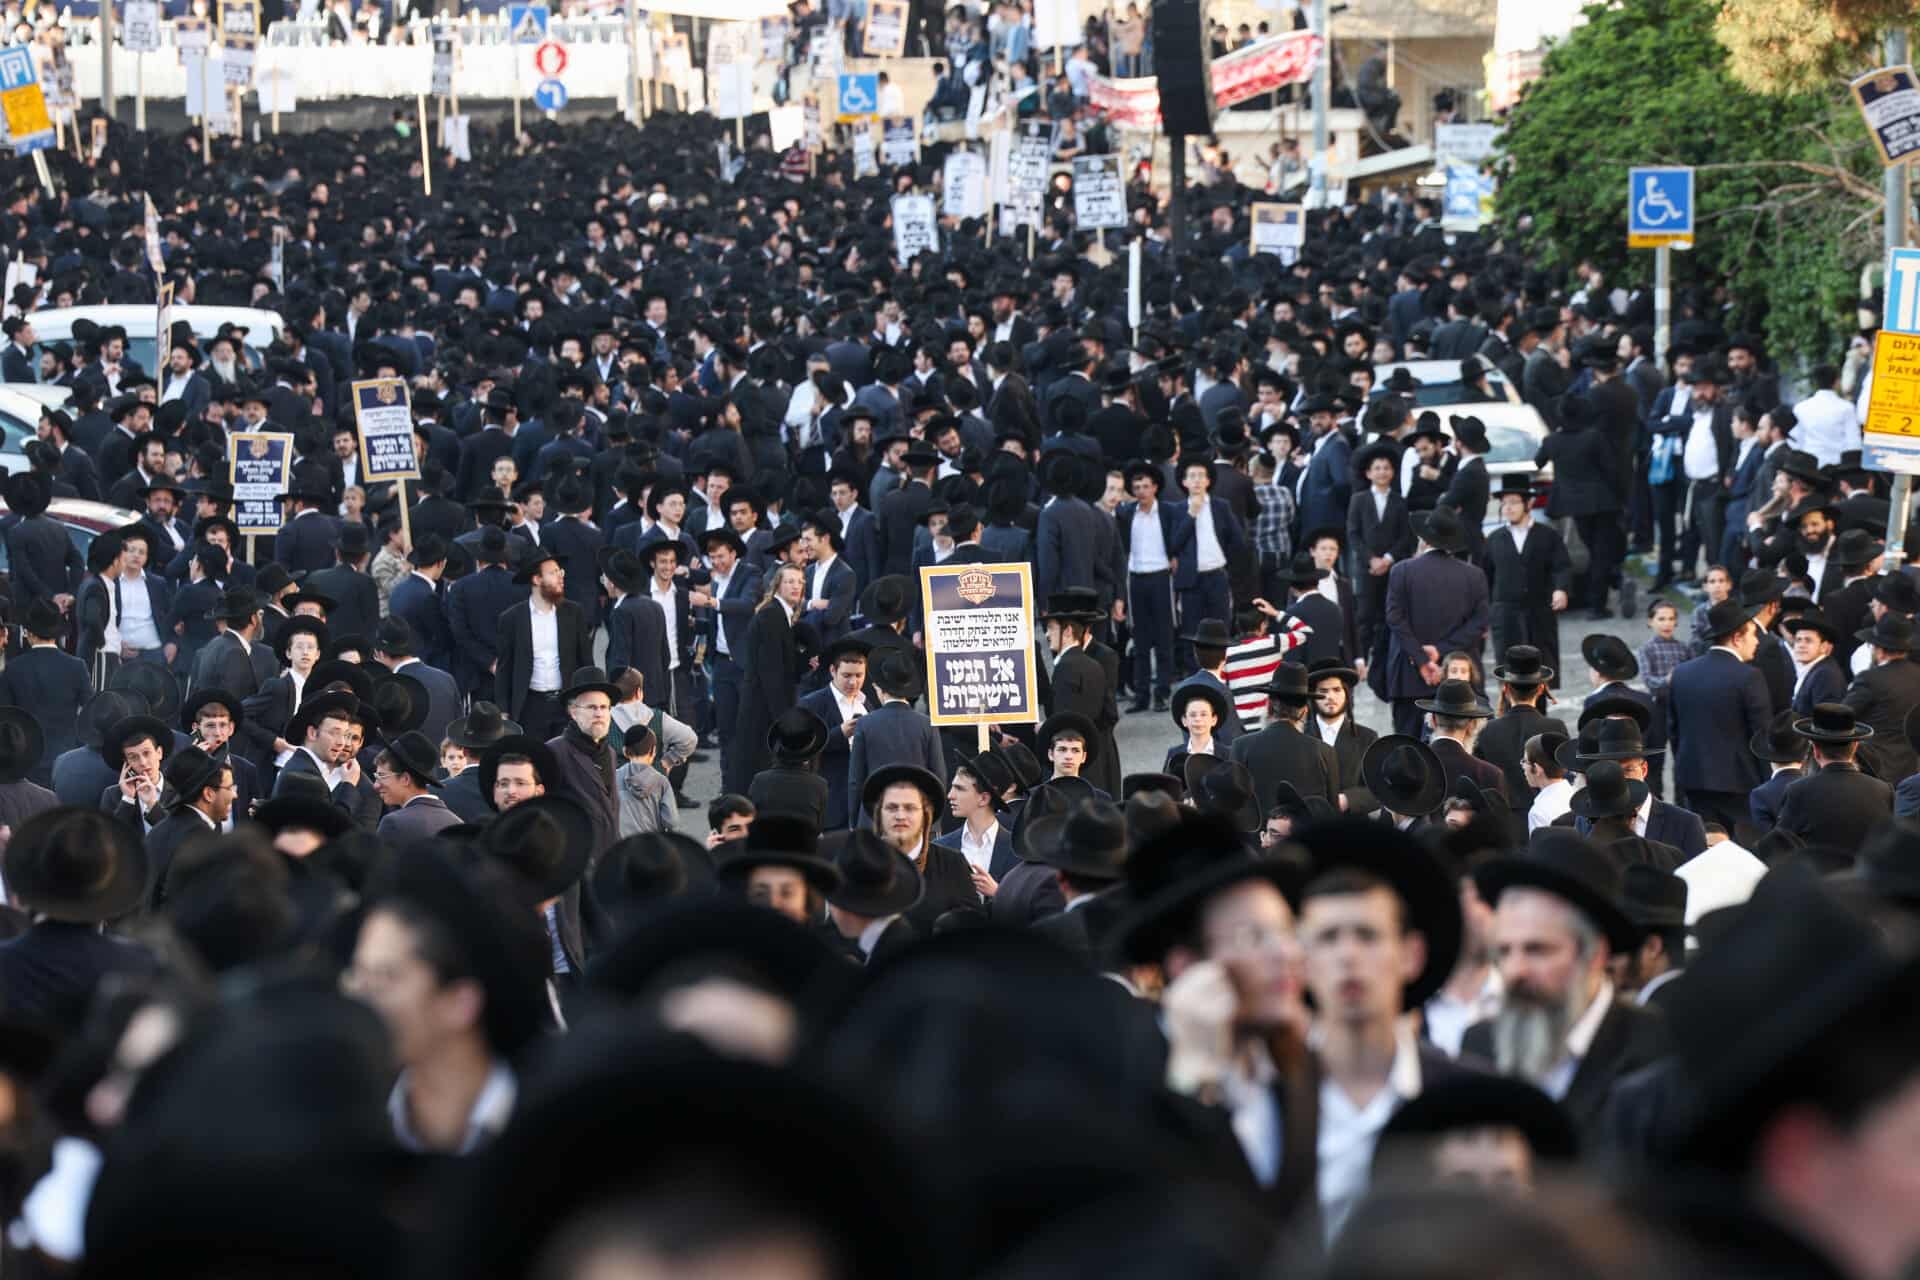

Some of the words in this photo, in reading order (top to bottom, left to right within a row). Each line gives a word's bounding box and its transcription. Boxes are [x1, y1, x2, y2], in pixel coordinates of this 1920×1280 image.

[1893, 339, 1920, 351] לום
[1900, 416, 1913, 433] 2
[937, 615, 965, 624] ישיבת
[1004, 612, 1019, 622] אנו
[940, 627, 965, 636] חדרה
[967, 626, 991, 638] יצחק
[993, 625, 1018, 634] כנסת
[983, 637, 1015, 648] קוראים
[946, 659, 986, 684] תגעו
[989, 654, 1015, 682] אל
[943, 682, 1021, 709] בישיבות!
